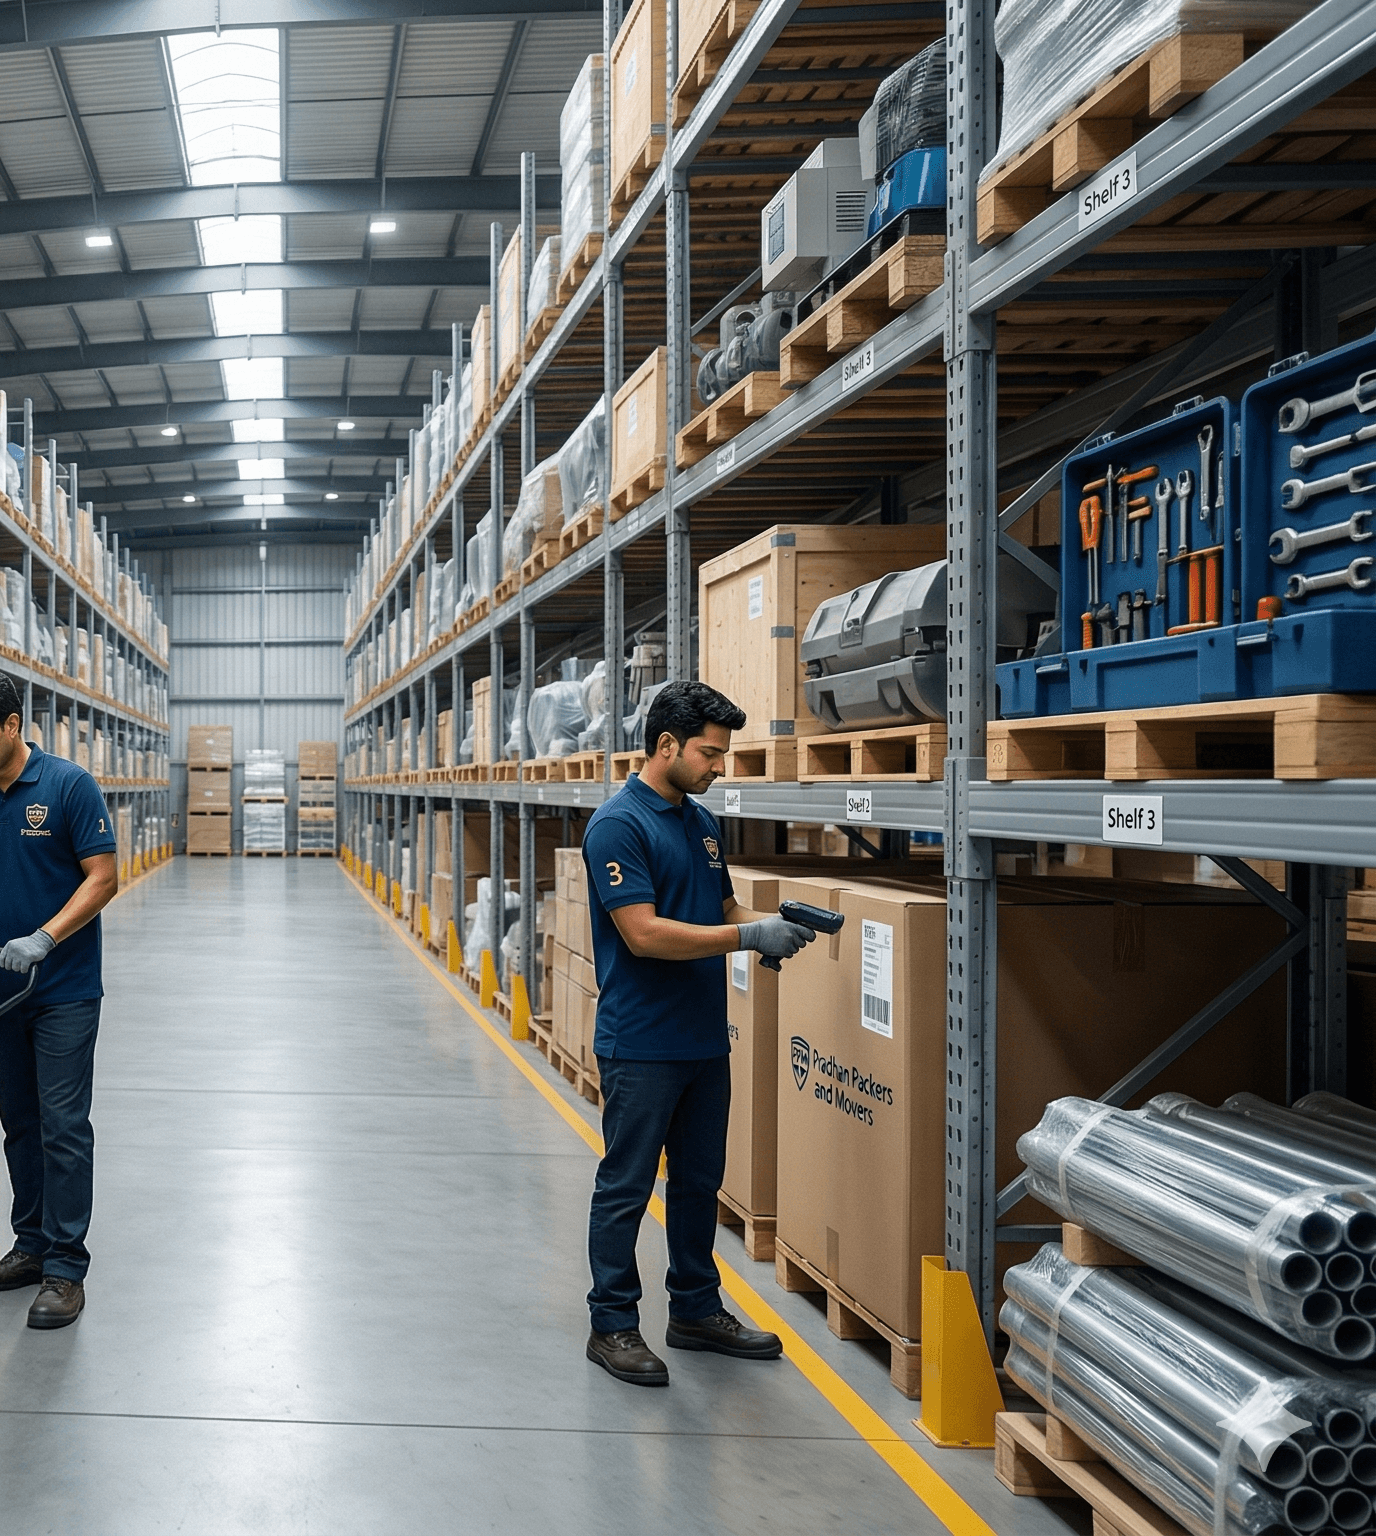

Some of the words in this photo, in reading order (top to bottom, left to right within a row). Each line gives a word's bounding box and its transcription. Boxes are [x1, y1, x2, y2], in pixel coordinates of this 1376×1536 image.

[1084, 174, 1120, 216] Shelf
[1122, 168, 1131, 190] 3
[866, 350, 872, 366] 3
[1108, 807, 1144, 829] Shelf
[1147, 809, 1155, 830] 3
[605, 861, 624, 886] 3
[813, 1048, 850, 1087] Pradhan
[852, 1066, 893, 1106] Packers
[814, 1081, 833, 1105] and
[835, 1086, 873, 1126] Movers
